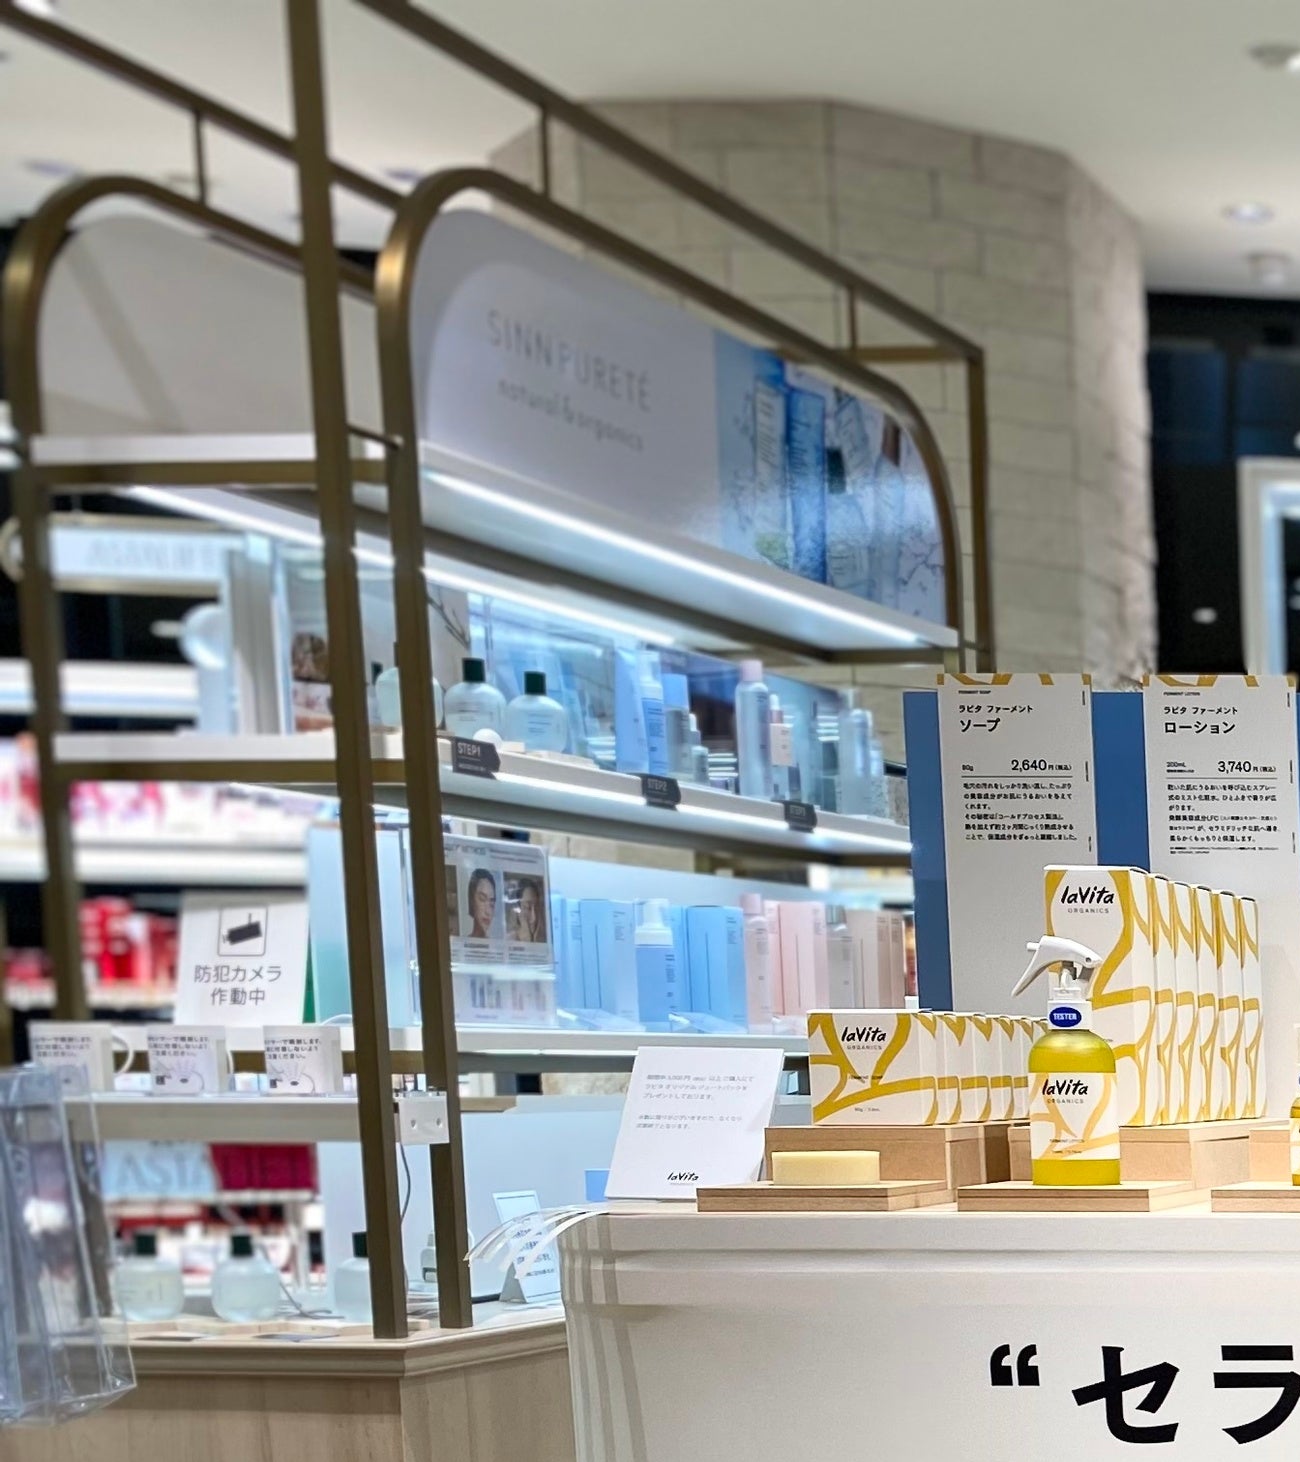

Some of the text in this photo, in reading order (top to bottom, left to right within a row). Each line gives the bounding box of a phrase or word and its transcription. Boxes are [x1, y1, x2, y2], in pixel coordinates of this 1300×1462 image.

[958, 704, 1034, 714] ラビタ ファーメント
[1163, 706, 1238, 716] ラビタ ファーメント
[960, 718, 1000, 732] ソープ
[1165, 721, 1235, 734] ローション
[1058, 883, 1114, 904] laVita
[194, 965, 281, 983] 防犯カメラ
[211, 988, 265, 1005] 作動中
[841, 1027, 886, 1042] laVita
[1042, 1079, 1088, 1095] laVita
